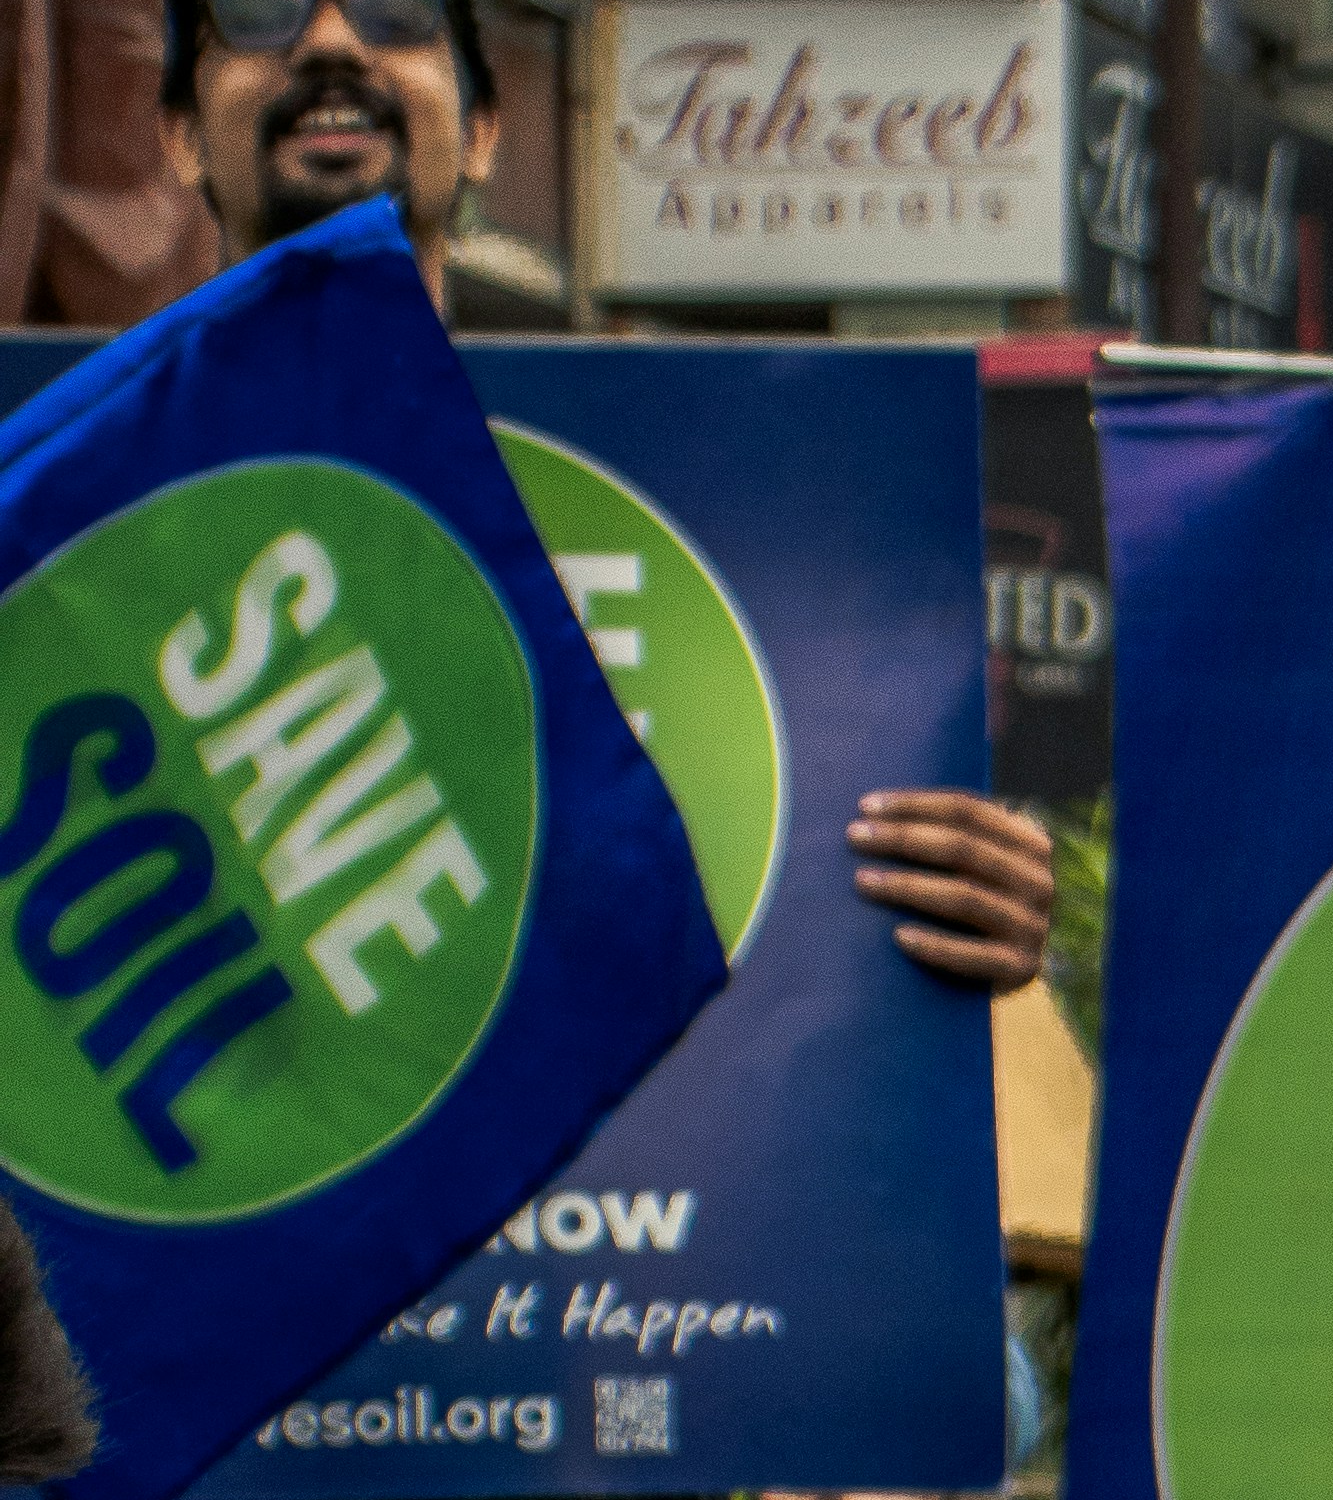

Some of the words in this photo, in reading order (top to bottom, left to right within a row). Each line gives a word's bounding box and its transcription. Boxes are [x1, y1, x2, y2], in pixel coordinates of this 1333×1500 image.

[614, 37, 1040, 172] Tahzeeb
[155, 527, 491, 1020] SAVE
[0, 688, 295, 1178] SOIL
[560, 1278, 787, 1358] Happen
